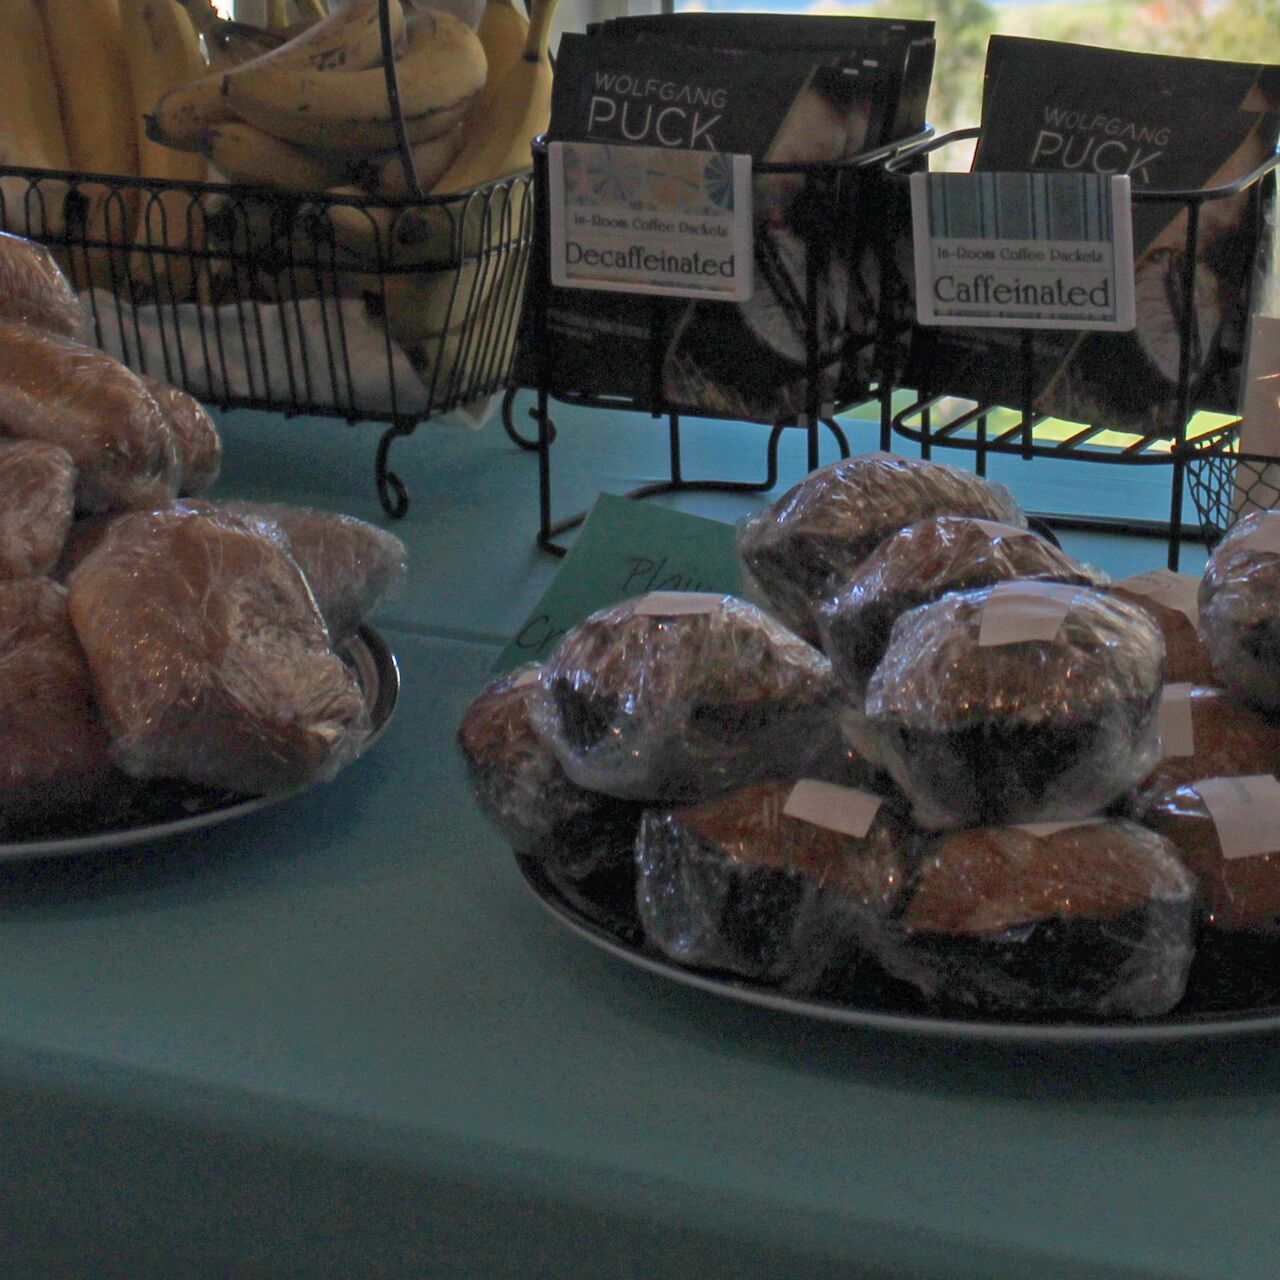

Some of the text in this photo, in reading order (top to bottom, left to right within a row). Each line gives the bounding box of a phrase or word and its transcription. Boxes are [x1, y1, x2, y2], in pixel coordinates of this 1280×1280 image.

[595, 71, 728, 109] WOLFGANG
[587, 95, 722, 151] PUCK
[1044, 106, 1171, 146] WOLFGANG
[1030, 130, 1162, 184] PUCK
[574, 213, 728, 238] In-Room Coffee Packets
[565, 241, 736, 278] Decaffeinated
[937, 246, 1104, 263] In-Room Coffee Packets
[933, 274, 1110, 307] Caffeinated
